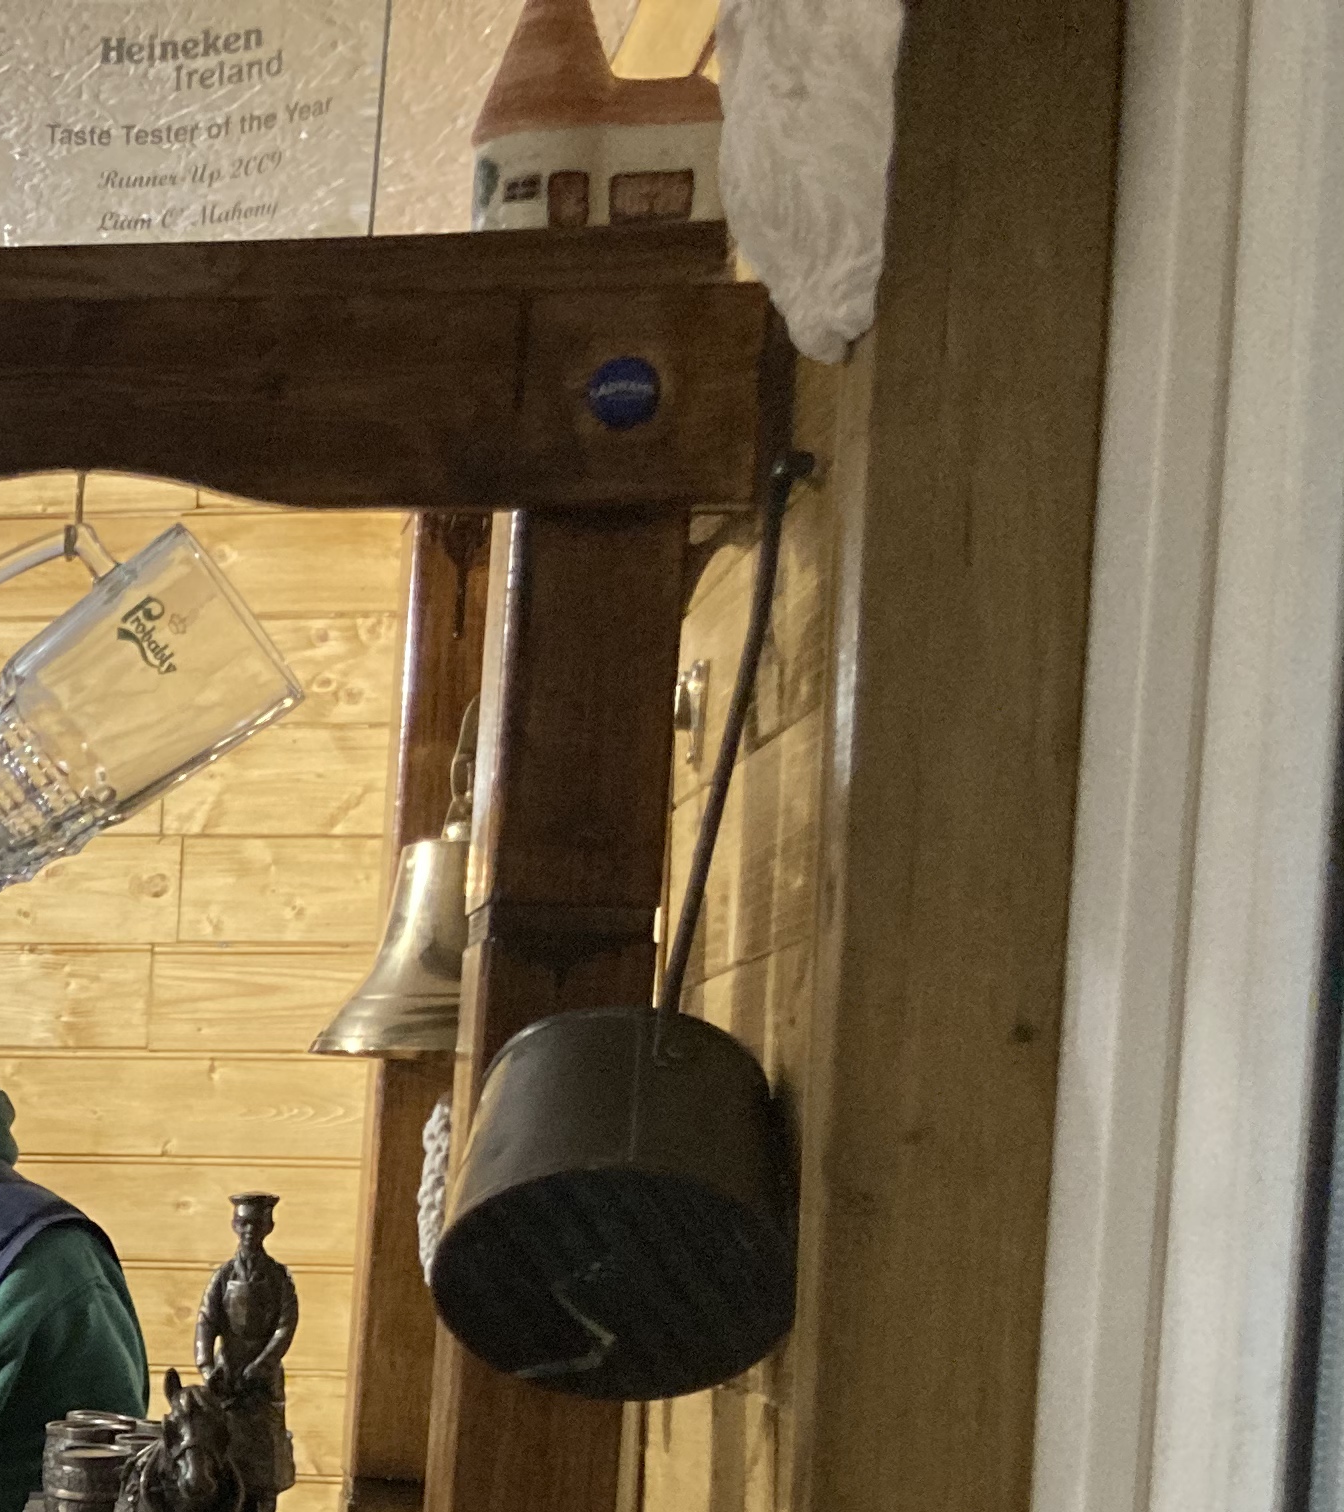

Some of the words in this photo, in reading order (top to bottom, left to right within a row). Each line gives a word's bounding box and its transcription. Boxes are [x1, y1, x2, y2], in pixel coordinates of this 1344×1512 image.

[100, 27, 264, 66] Heineken
[173, 49, 283, 91] Ireland
[46, 123, 112, 147] Taste
[121, 120, 200, 147] Tester
[207, 114, 233, 139] of
[239, 112, 278, 134] the
[285, 97, 334, 124] Year
[96, 210, 153, 231] Liam
[116, 594, 177, 675] Probably
